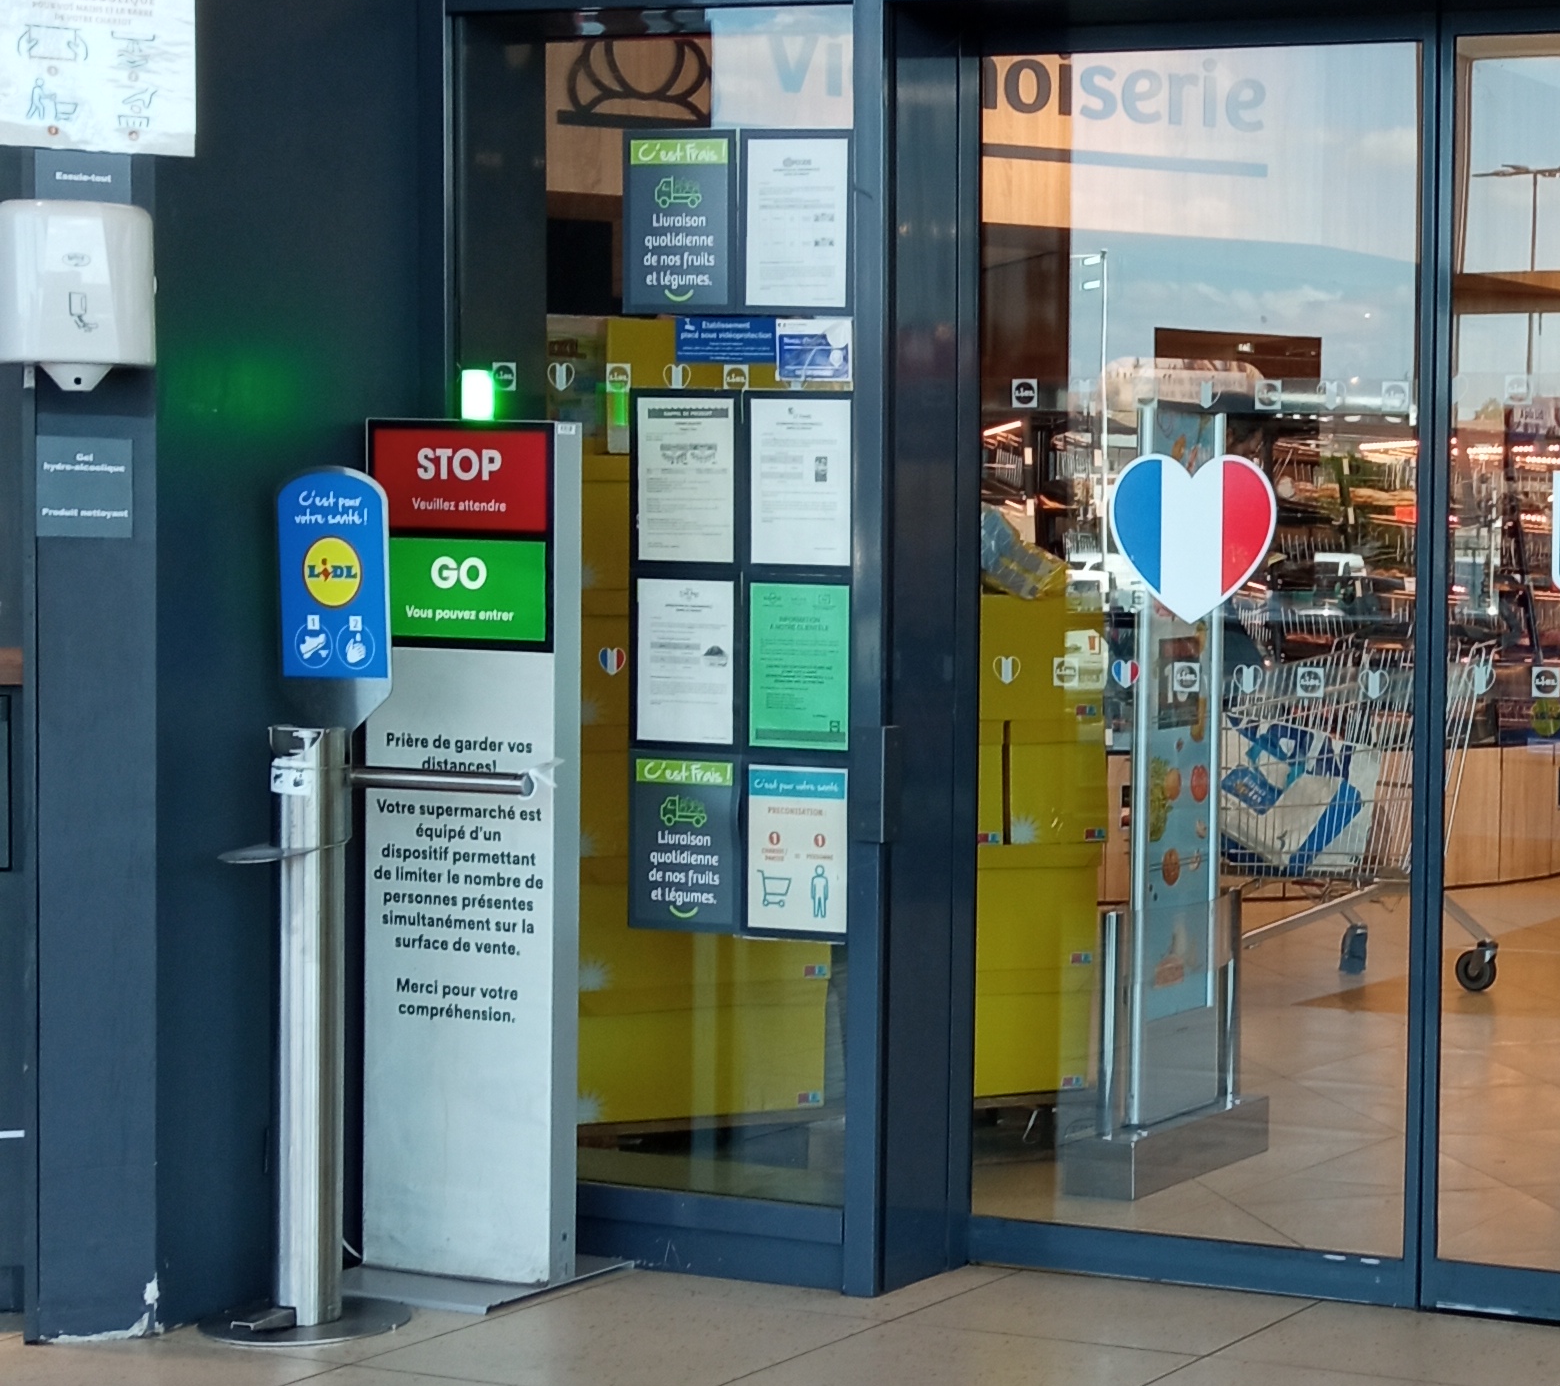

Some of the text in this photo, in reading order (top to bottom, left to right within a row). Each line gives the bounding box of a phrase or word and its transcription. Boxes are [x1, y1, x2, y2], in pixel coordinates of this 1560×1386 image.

[652, 213, 706, 227] Livraison
[644, 232, 714, 249] quotidienne
[643, 252, 715, 270] de nos fruits
[646, 271, 713, 290] et légumes.
[416, 447, 502, 481] STOP
[299, 490, 362, 513] C'est pour
[412, 497, 506, 512] Veuillez attendre
[42, 507, 78, 517] Produit
[295, 509, 325, 525] votre
[430, 556, 488, 591] GO
[405, 605, 514, 621] Vous pouvez entrer
[386, 732, 533, 753] Prière de garder vos
[376, 798, 542, 821] Votre supermarché est
[415, 823, 502, 843] équipé d'un
[657, 830, 711, 847] Livraison
[381, 843, 536, 866] dispositif permettant
[650, 850, 719, 866] quotidienne
[373, 865, 543, 889] de limiter le nombre de
[648, 868, 720, 887] de nos fruits
[383, 891, 534, 911] personnes présentes
[651, 886, 717, 906] et légumes.
[382, 910, 535, 934] simultanément sur la
[395, 934, 521, 956] surface de vente.
[396, 977, 518, 1001] Merci pour votre
[398, 1002, 516, 1023] compréhension.
